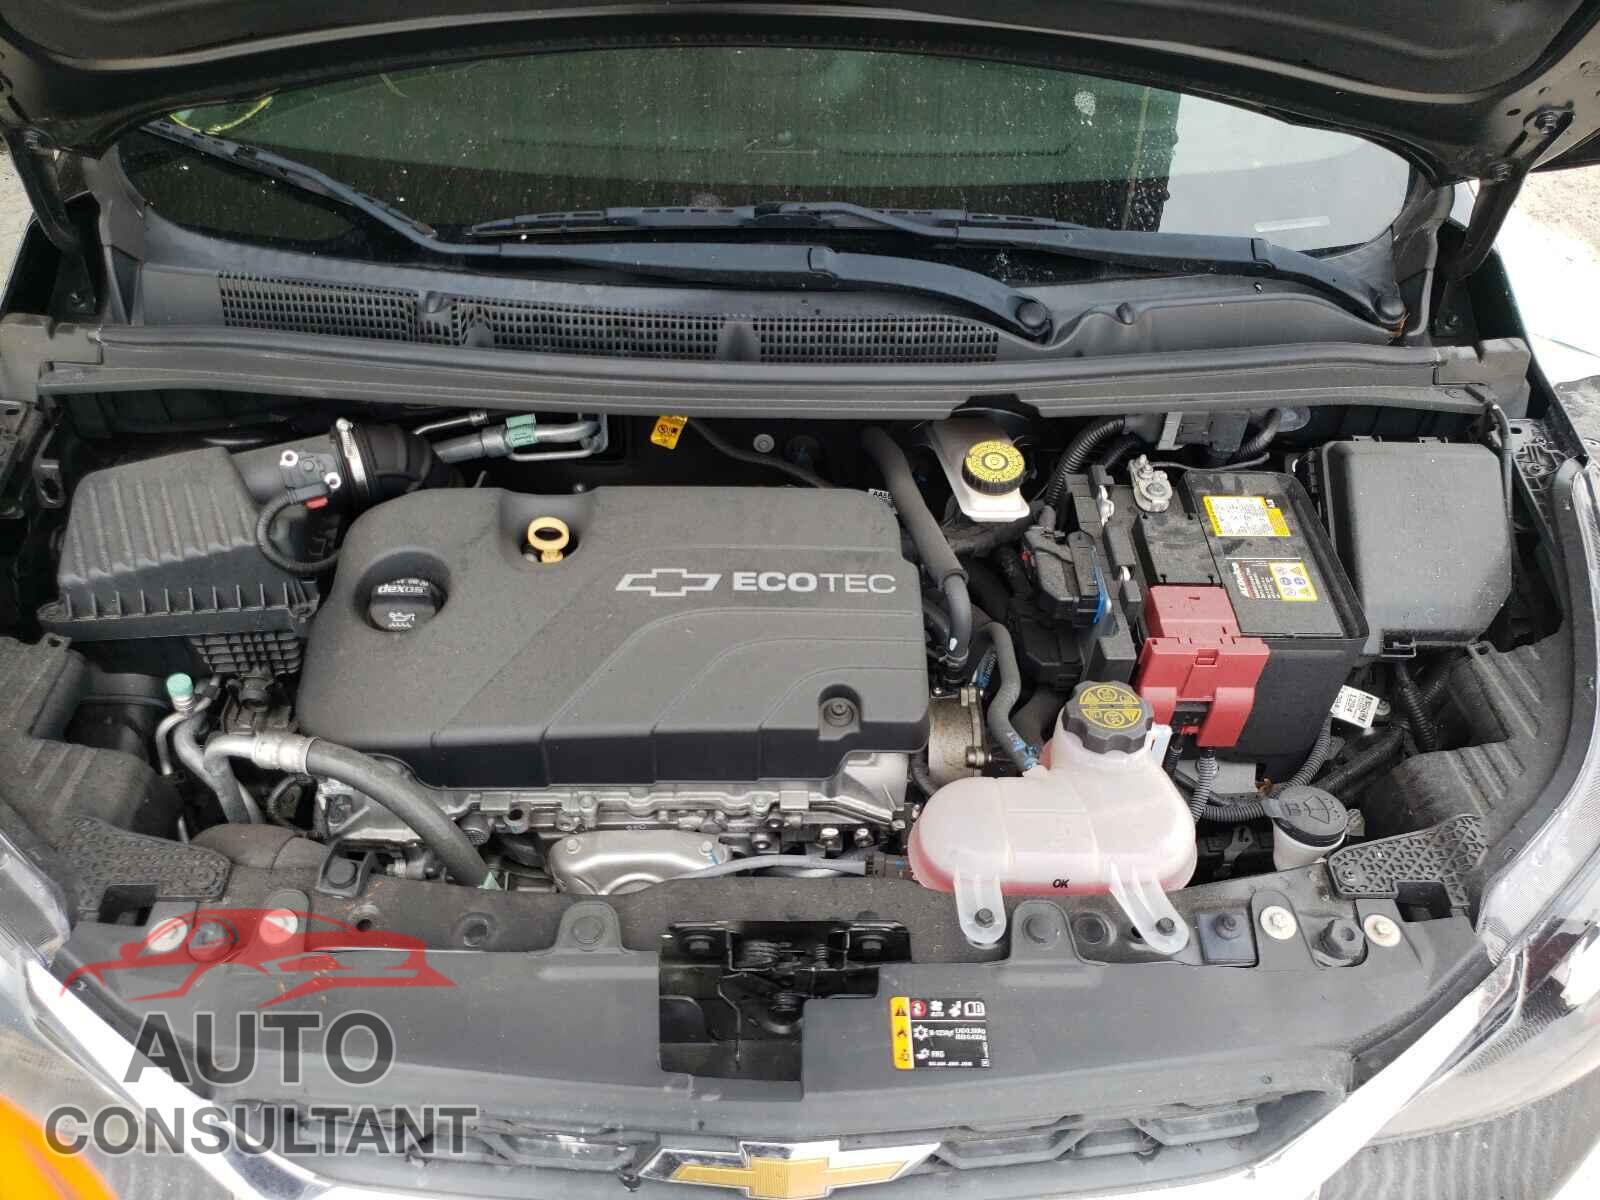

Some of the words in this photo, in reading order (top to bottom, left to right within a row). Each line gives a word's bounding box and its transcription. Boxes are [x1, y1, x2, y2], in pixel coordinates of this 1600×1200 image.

[733, 571, 897, 594] ECOTEC
[378, 584, 424, 594] dexos
[1053, 879, 1070, 889] OK
